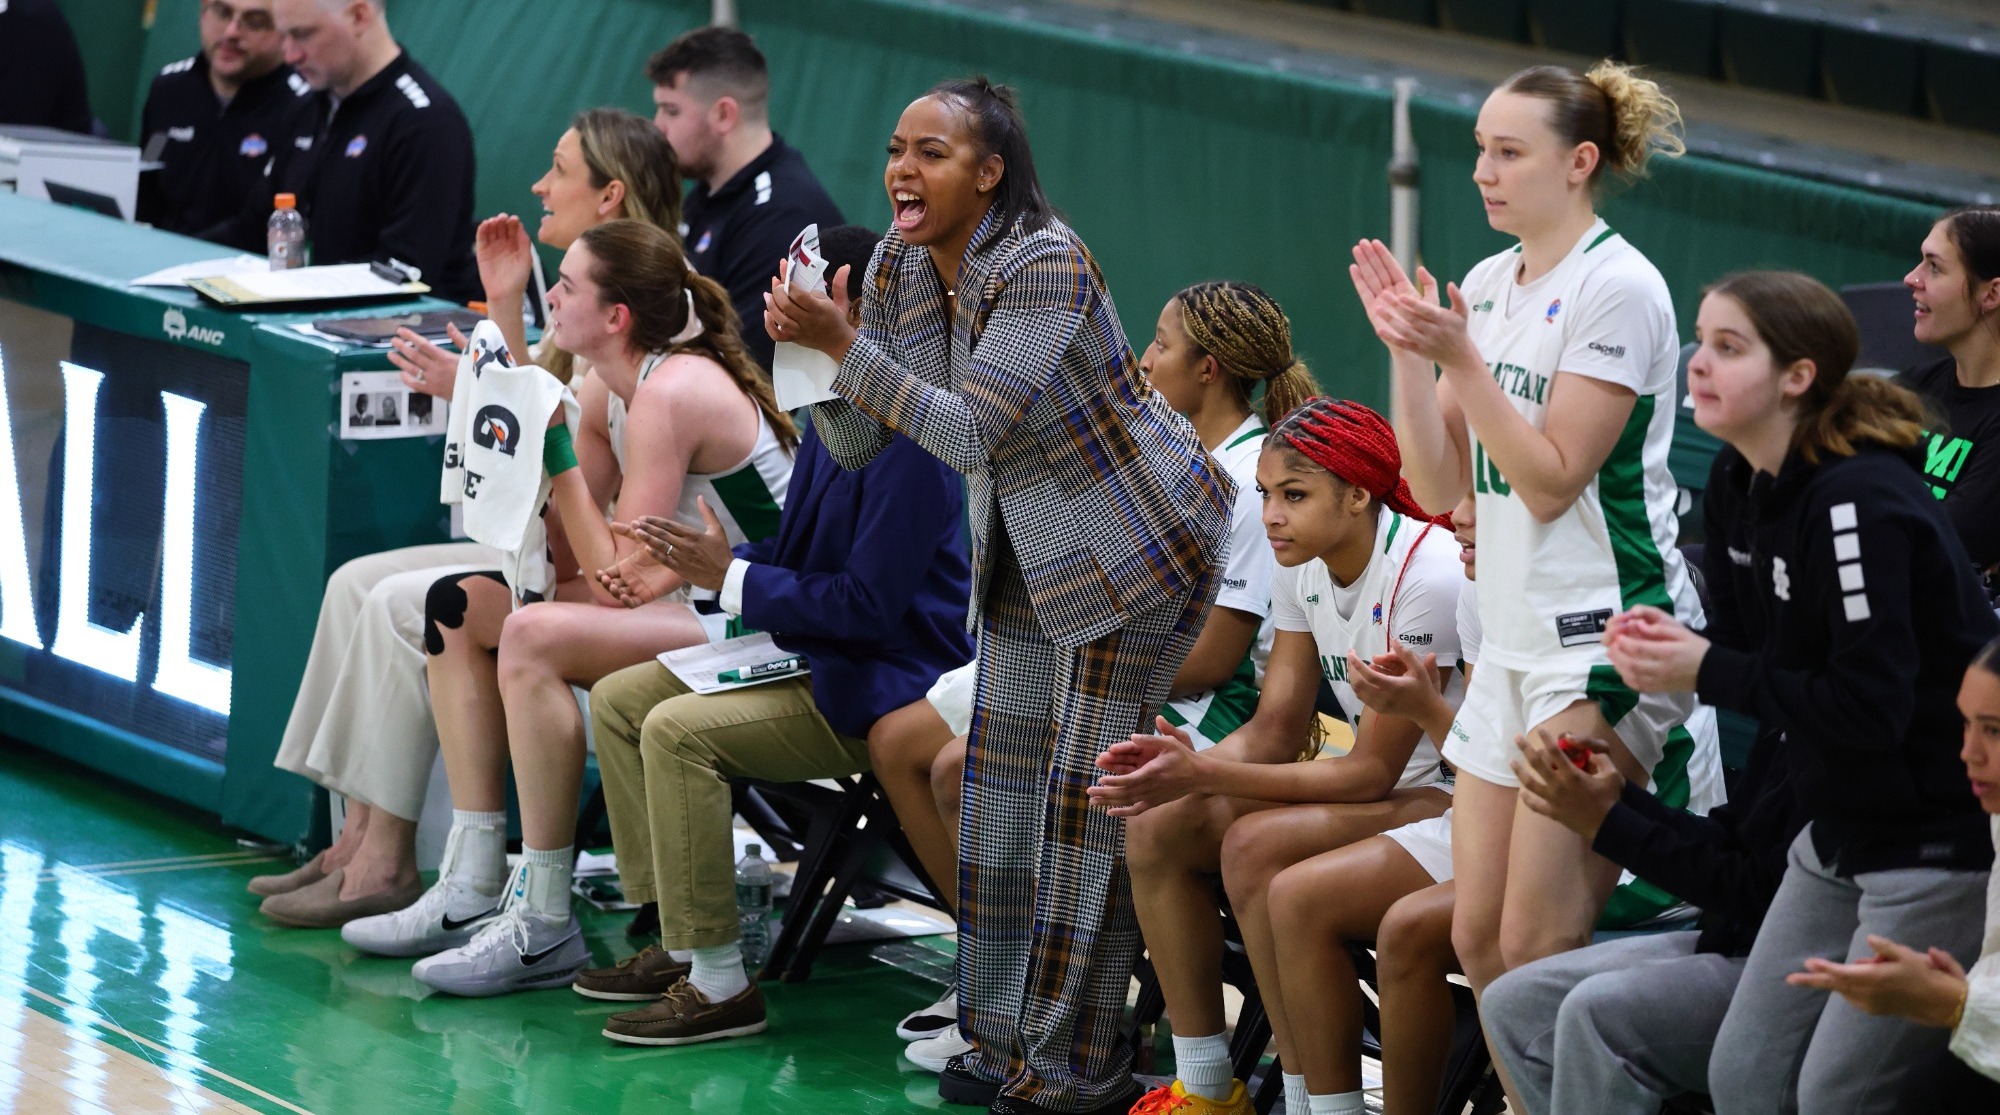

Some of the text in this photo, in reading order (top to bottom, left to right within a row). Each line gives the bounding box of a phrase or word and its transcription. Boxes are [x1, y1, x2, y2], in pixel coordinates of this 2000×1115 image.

[187, 325, 225, 346] ANC
[1588, 341, 1626, 357] capelli
[1486, 362, 1548, 405] ATTAN
[1221, 577, 1248, 588] apelli
[1399, 633, 1433, 644] capelli
